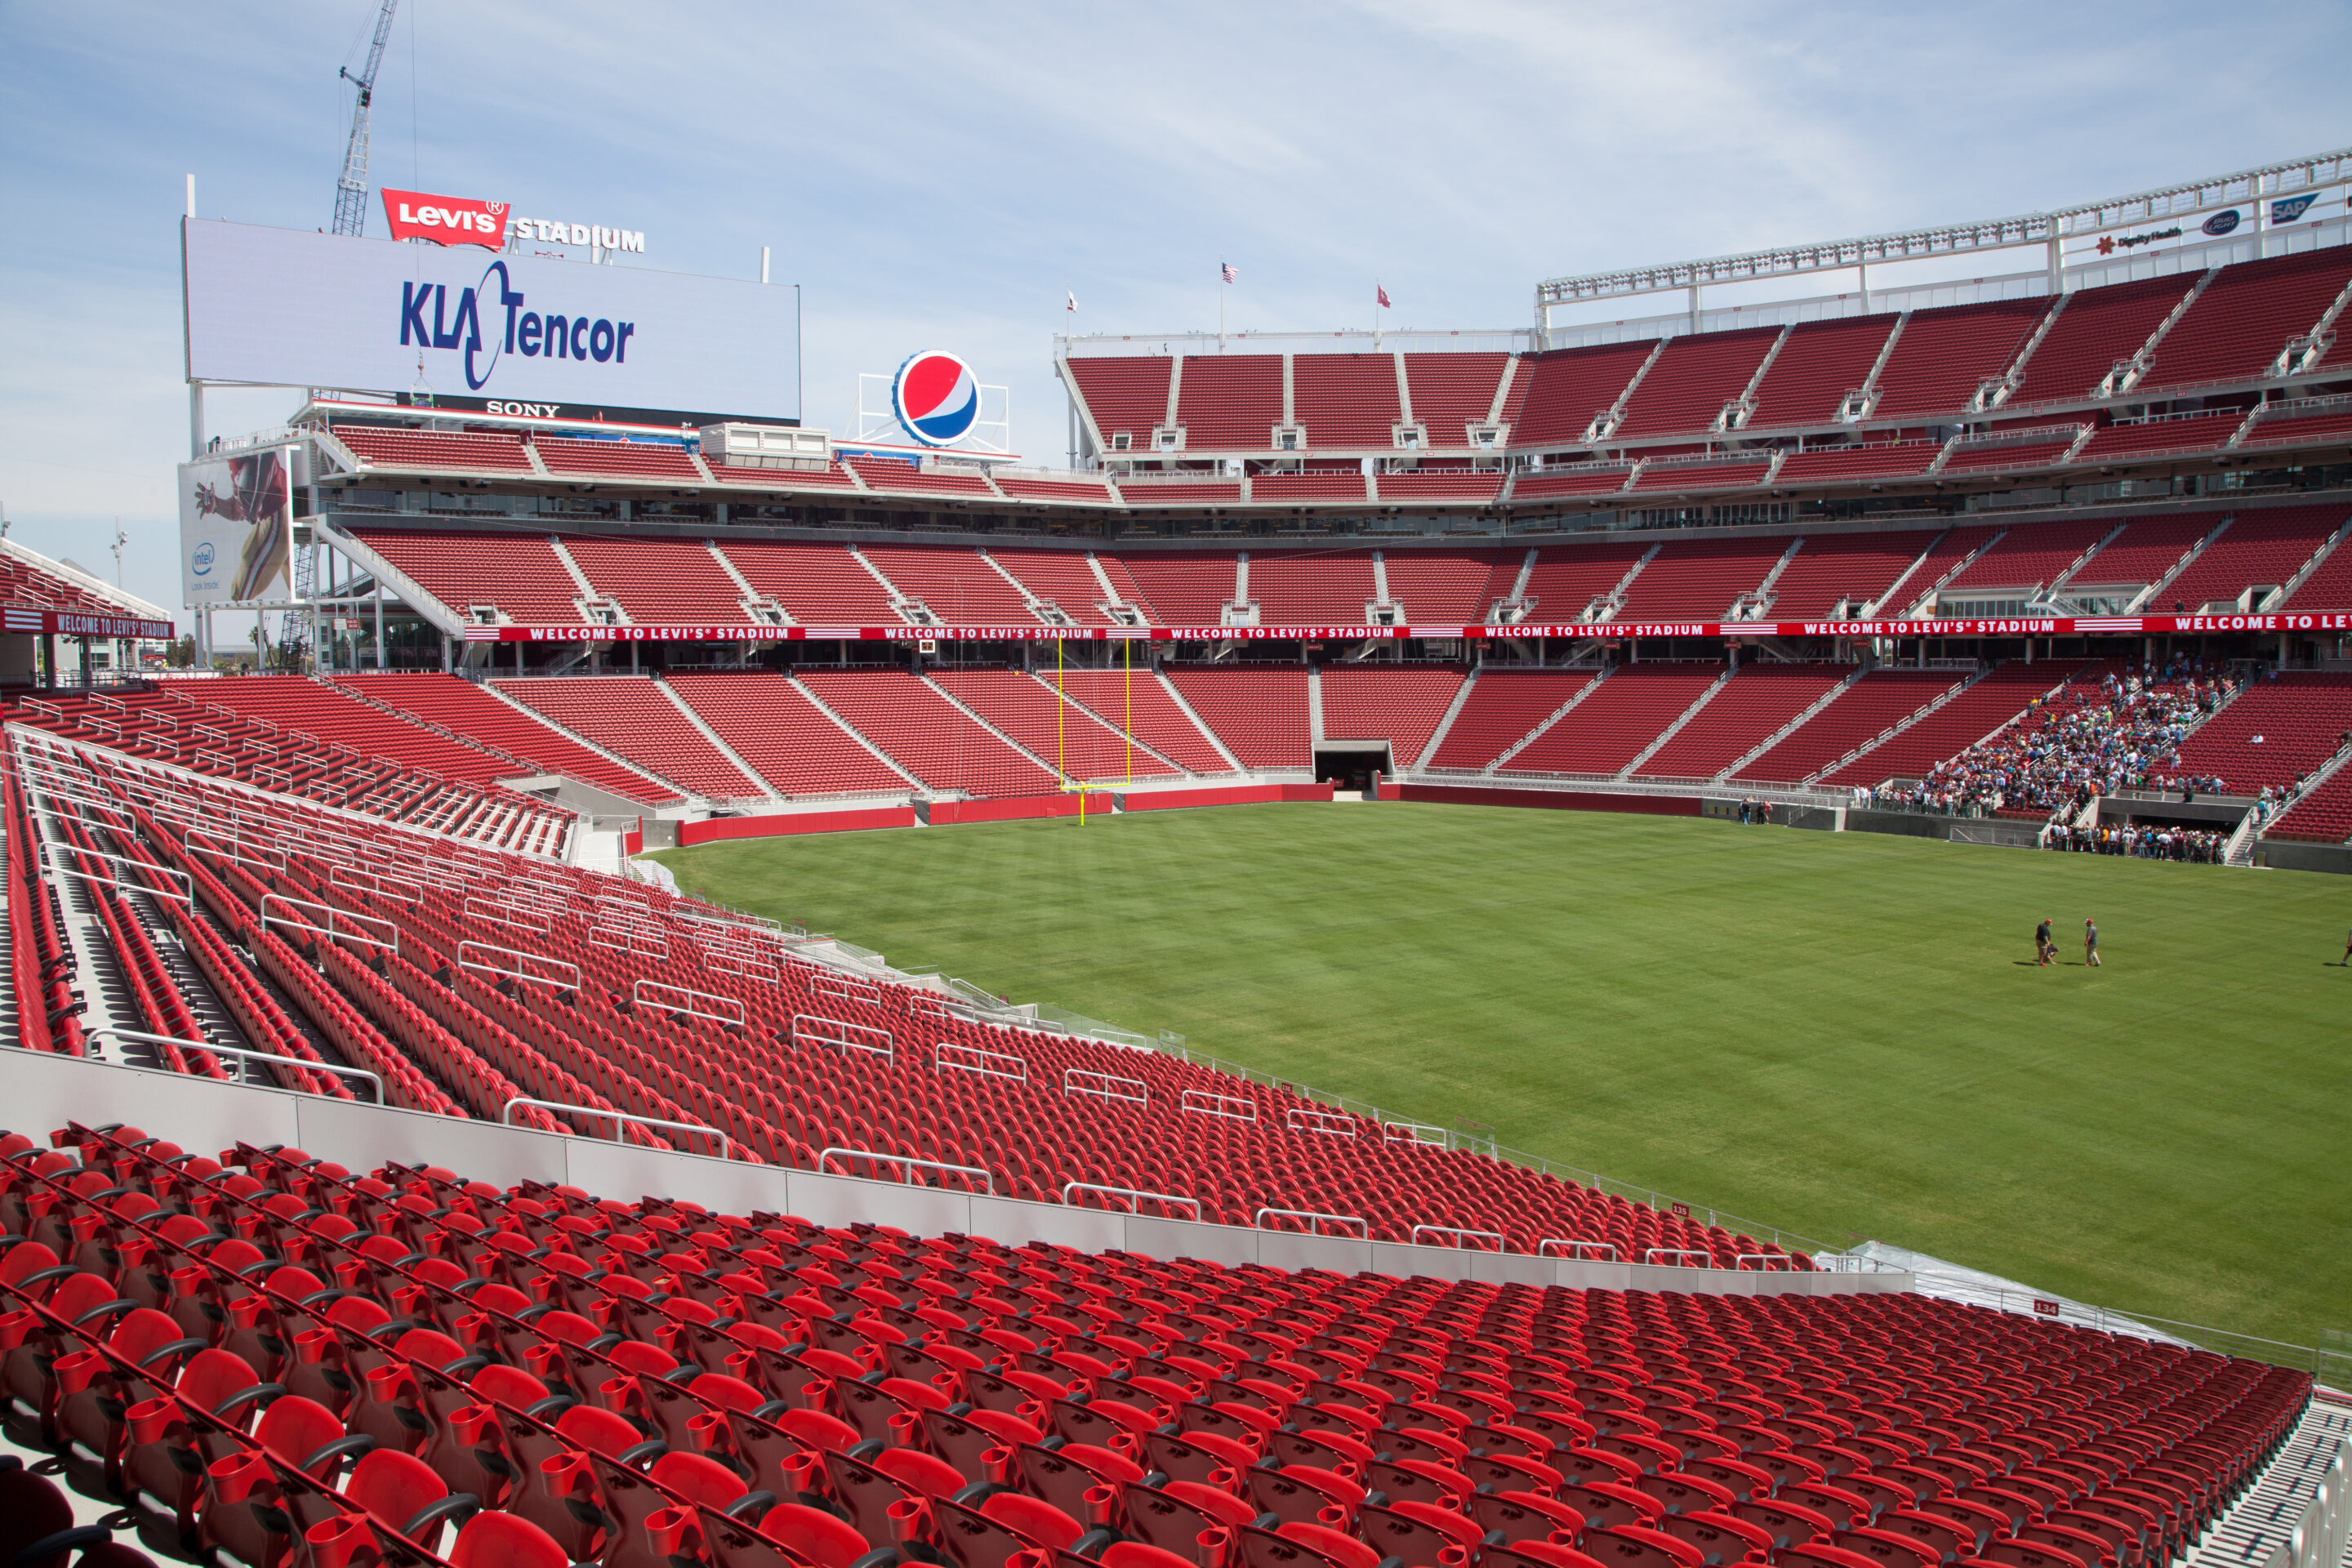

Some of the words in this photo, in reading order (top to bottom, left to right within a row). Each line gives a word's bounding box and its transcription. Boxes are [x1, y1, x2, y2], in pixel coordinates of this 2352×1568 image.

[2273, 200, 2306, 220] SAP
[2208, 220, 2238, 231] LIGHT
[2213, 216, 2235, 225] BUD
[516, 217, 644, 252] STADIUM
[2118, 234, 2151, 247] Dignity
[2151, 226, 2182, 241] Health
[400, 281, 482, 352] KLA
[500, 292, 634, 363] Tencor
[487, 400, 560, 418] SONY
[194, 549, 211, 565] intel
[191, 581, 203, 590] Look
[58, 614, 99, 633] WELCOME
[100, 617, 111, 634] TO
[140, 621, 169, 638] STADIUM
[1804, 622, 1882, 635] WELCOME
[1888, 622, 1908, 634] TO
[1977, 621, 2054, 632] STADIUM
[2175, 616, 2276, 630] WELCOME
[2285, 615, 2313, 629] TO
[2322, 614, 2352, 628] LE
[531, 628, 617, 639] WELCOME
[623, 628, 644, 639] TO
[716, 628, 788, 639] STADIUM
[884, 628, 954, 639] WELCOME
[959, 628, 977, 639] TO
[1035, 628, 1093, 639] STADIUM
[1170, 629, 1241, 639] WELCOME
[1246, 629, 1265, 639] TO
[1328, 628, 1394, 638] STADIUM
[1485, 626, 1551, 637] WELCOME
[1556, 626, 1574, 636] TO
[1636, 625, 1703, 635] STADIUM
[1673, 1205, 1686, 1214] 135
[2036, 1303, 2056, 1314] 134
